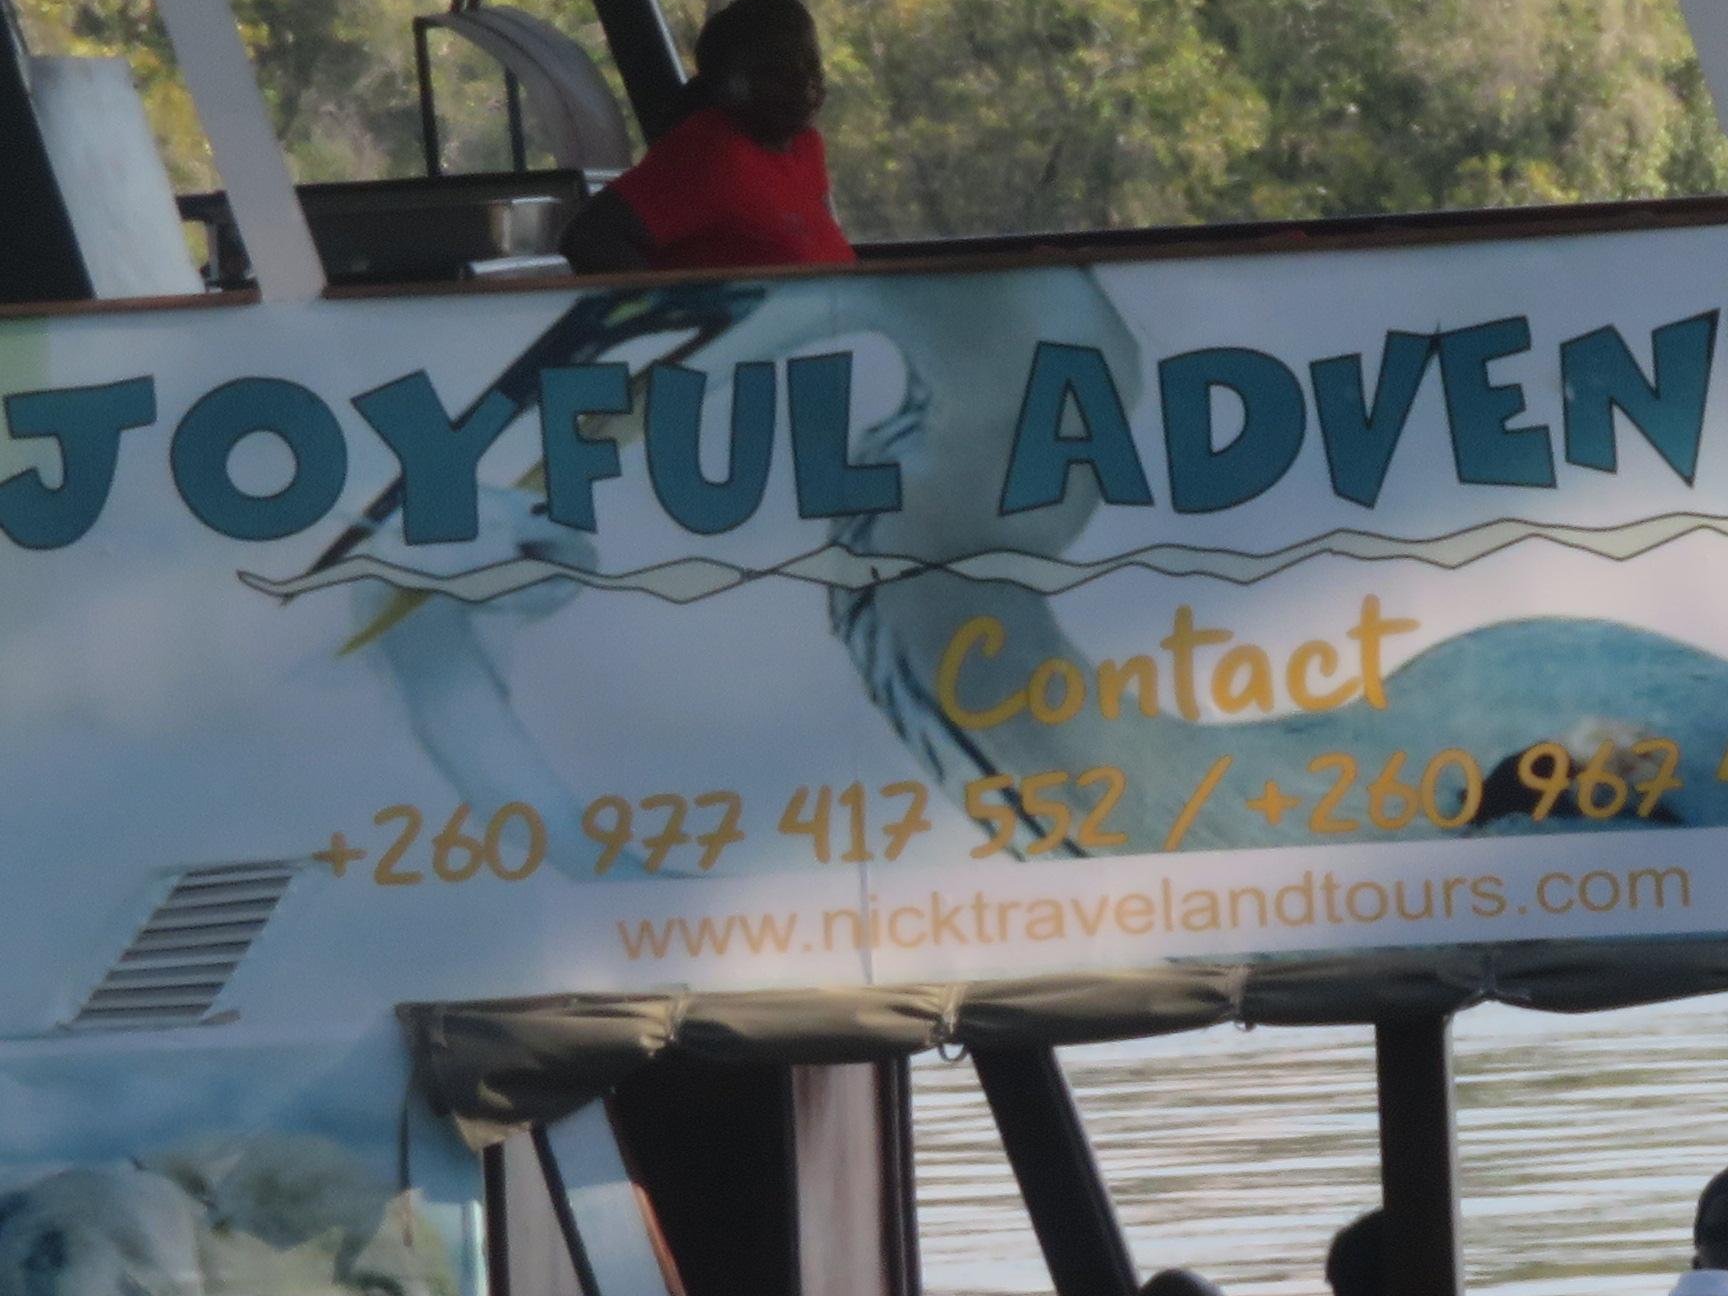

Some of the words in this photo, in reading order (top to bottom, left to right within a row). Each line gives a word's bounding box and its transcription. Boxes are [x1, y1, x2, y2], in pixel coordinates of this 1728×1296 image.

[0, 350, 903, 551] JOYFUL
[935, 592, 1420, 732] Contact
[314, 800, 549, 887] +260
[580, 791, 746, 875] 977
[776, 780, 933, 866] 417
[963, 766, 1129, 861] 552
[1245, 746, 1485, 836] +260
[1515, 737, 1685, 822] 967
[618, 858, 1693, 961] www.nicktravelandtours.com
